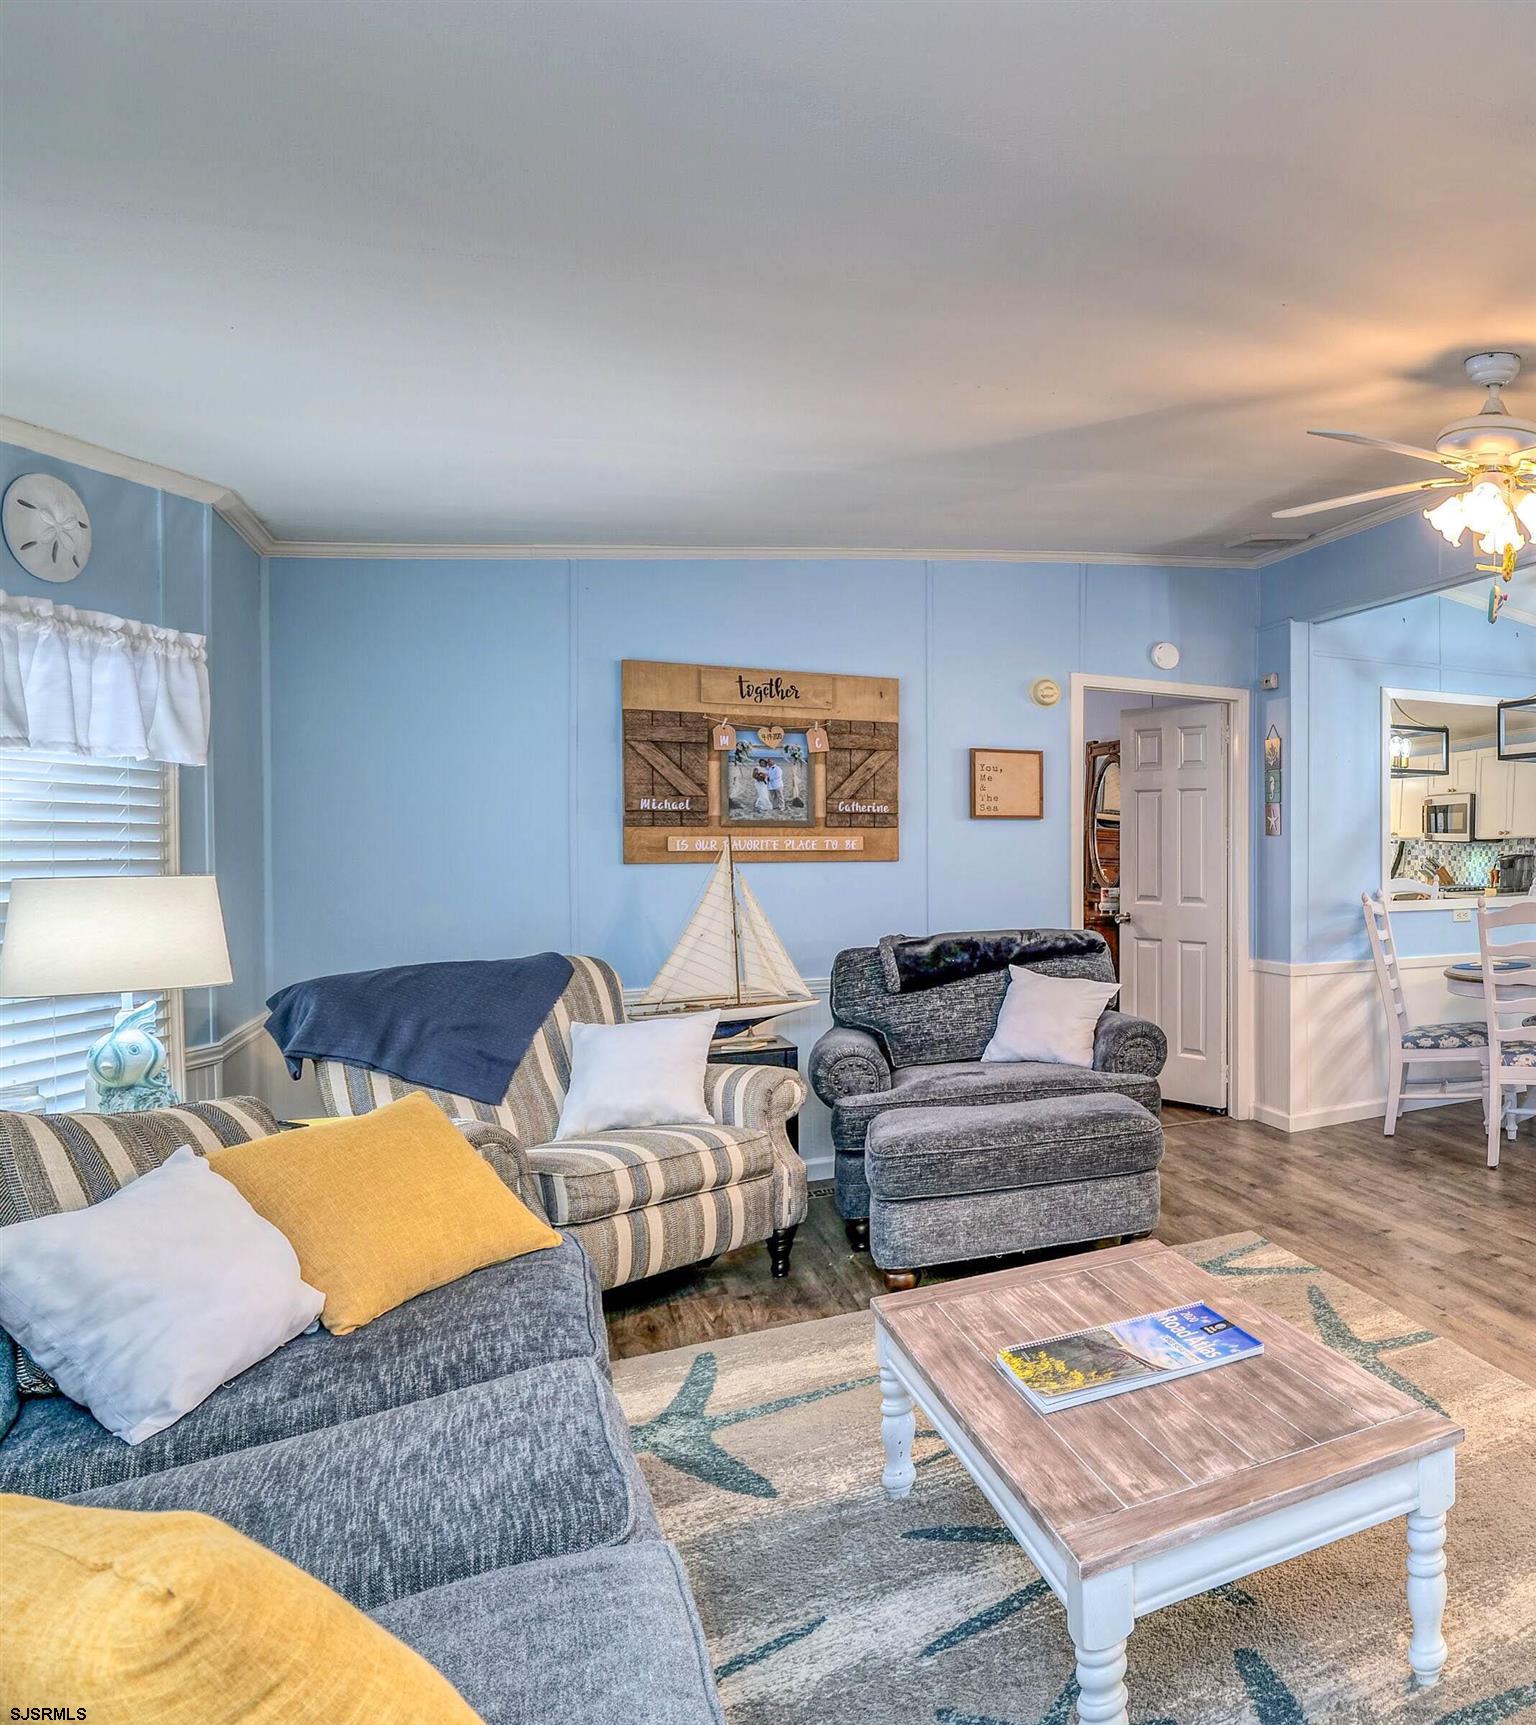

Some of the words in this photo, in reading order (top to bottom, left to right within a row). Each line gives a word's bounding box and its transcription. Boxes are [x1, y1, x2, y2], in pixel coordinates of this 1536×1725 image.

[735, 674, 800, 703] together
[719, 735, 729, 746] M
[815, 737, 822, 749] C
[979, 763, 1003, 775] You,
[979, 774, 993, 782] Me
[979, 793, 999, 802] The
[640, 798, 691, 811] Michael
[838, 801, 890, 813] Catherine
[979, 803, 999, 812] Sea
[676, 840, 689, 851] IS
[695, 840, 717, 851] OUR
[784, 840, 818, 850] PLACE
[823, 840, 838, 850] TO
[845, 840, 858, 850] BE
[1158, 1315, 1198, 1338] Road
[1185, 1336, 1222, 1358] Atlas
